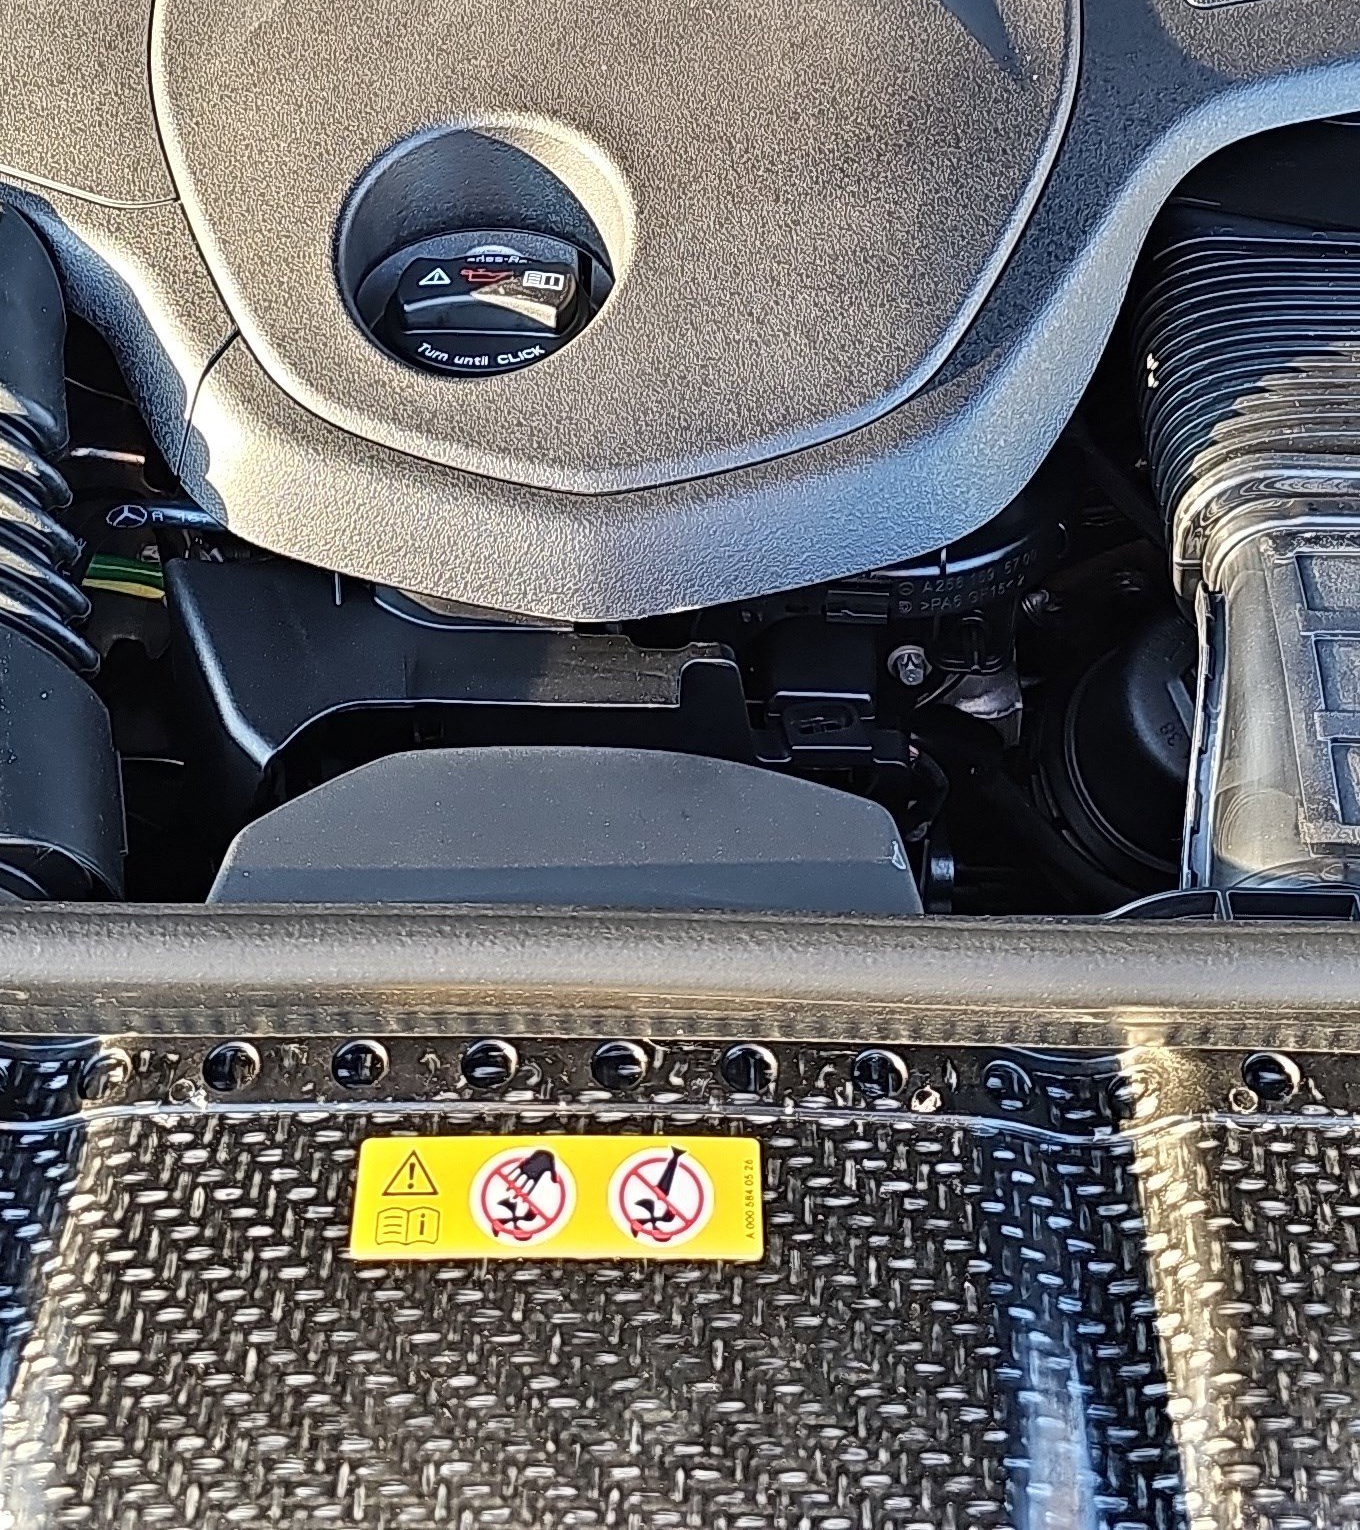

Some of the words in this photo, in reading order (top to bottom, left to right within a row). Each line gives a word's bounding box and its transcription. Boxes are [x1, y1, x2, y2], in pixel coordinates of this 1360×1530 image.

[418, 342, 449, 362] Turn
[454, 355, 489, 366] until
[497, 344, 546, 365] CLICK
[744, 1158, 754, 1171] 26
[745, 1210, 755, 1230] 000
